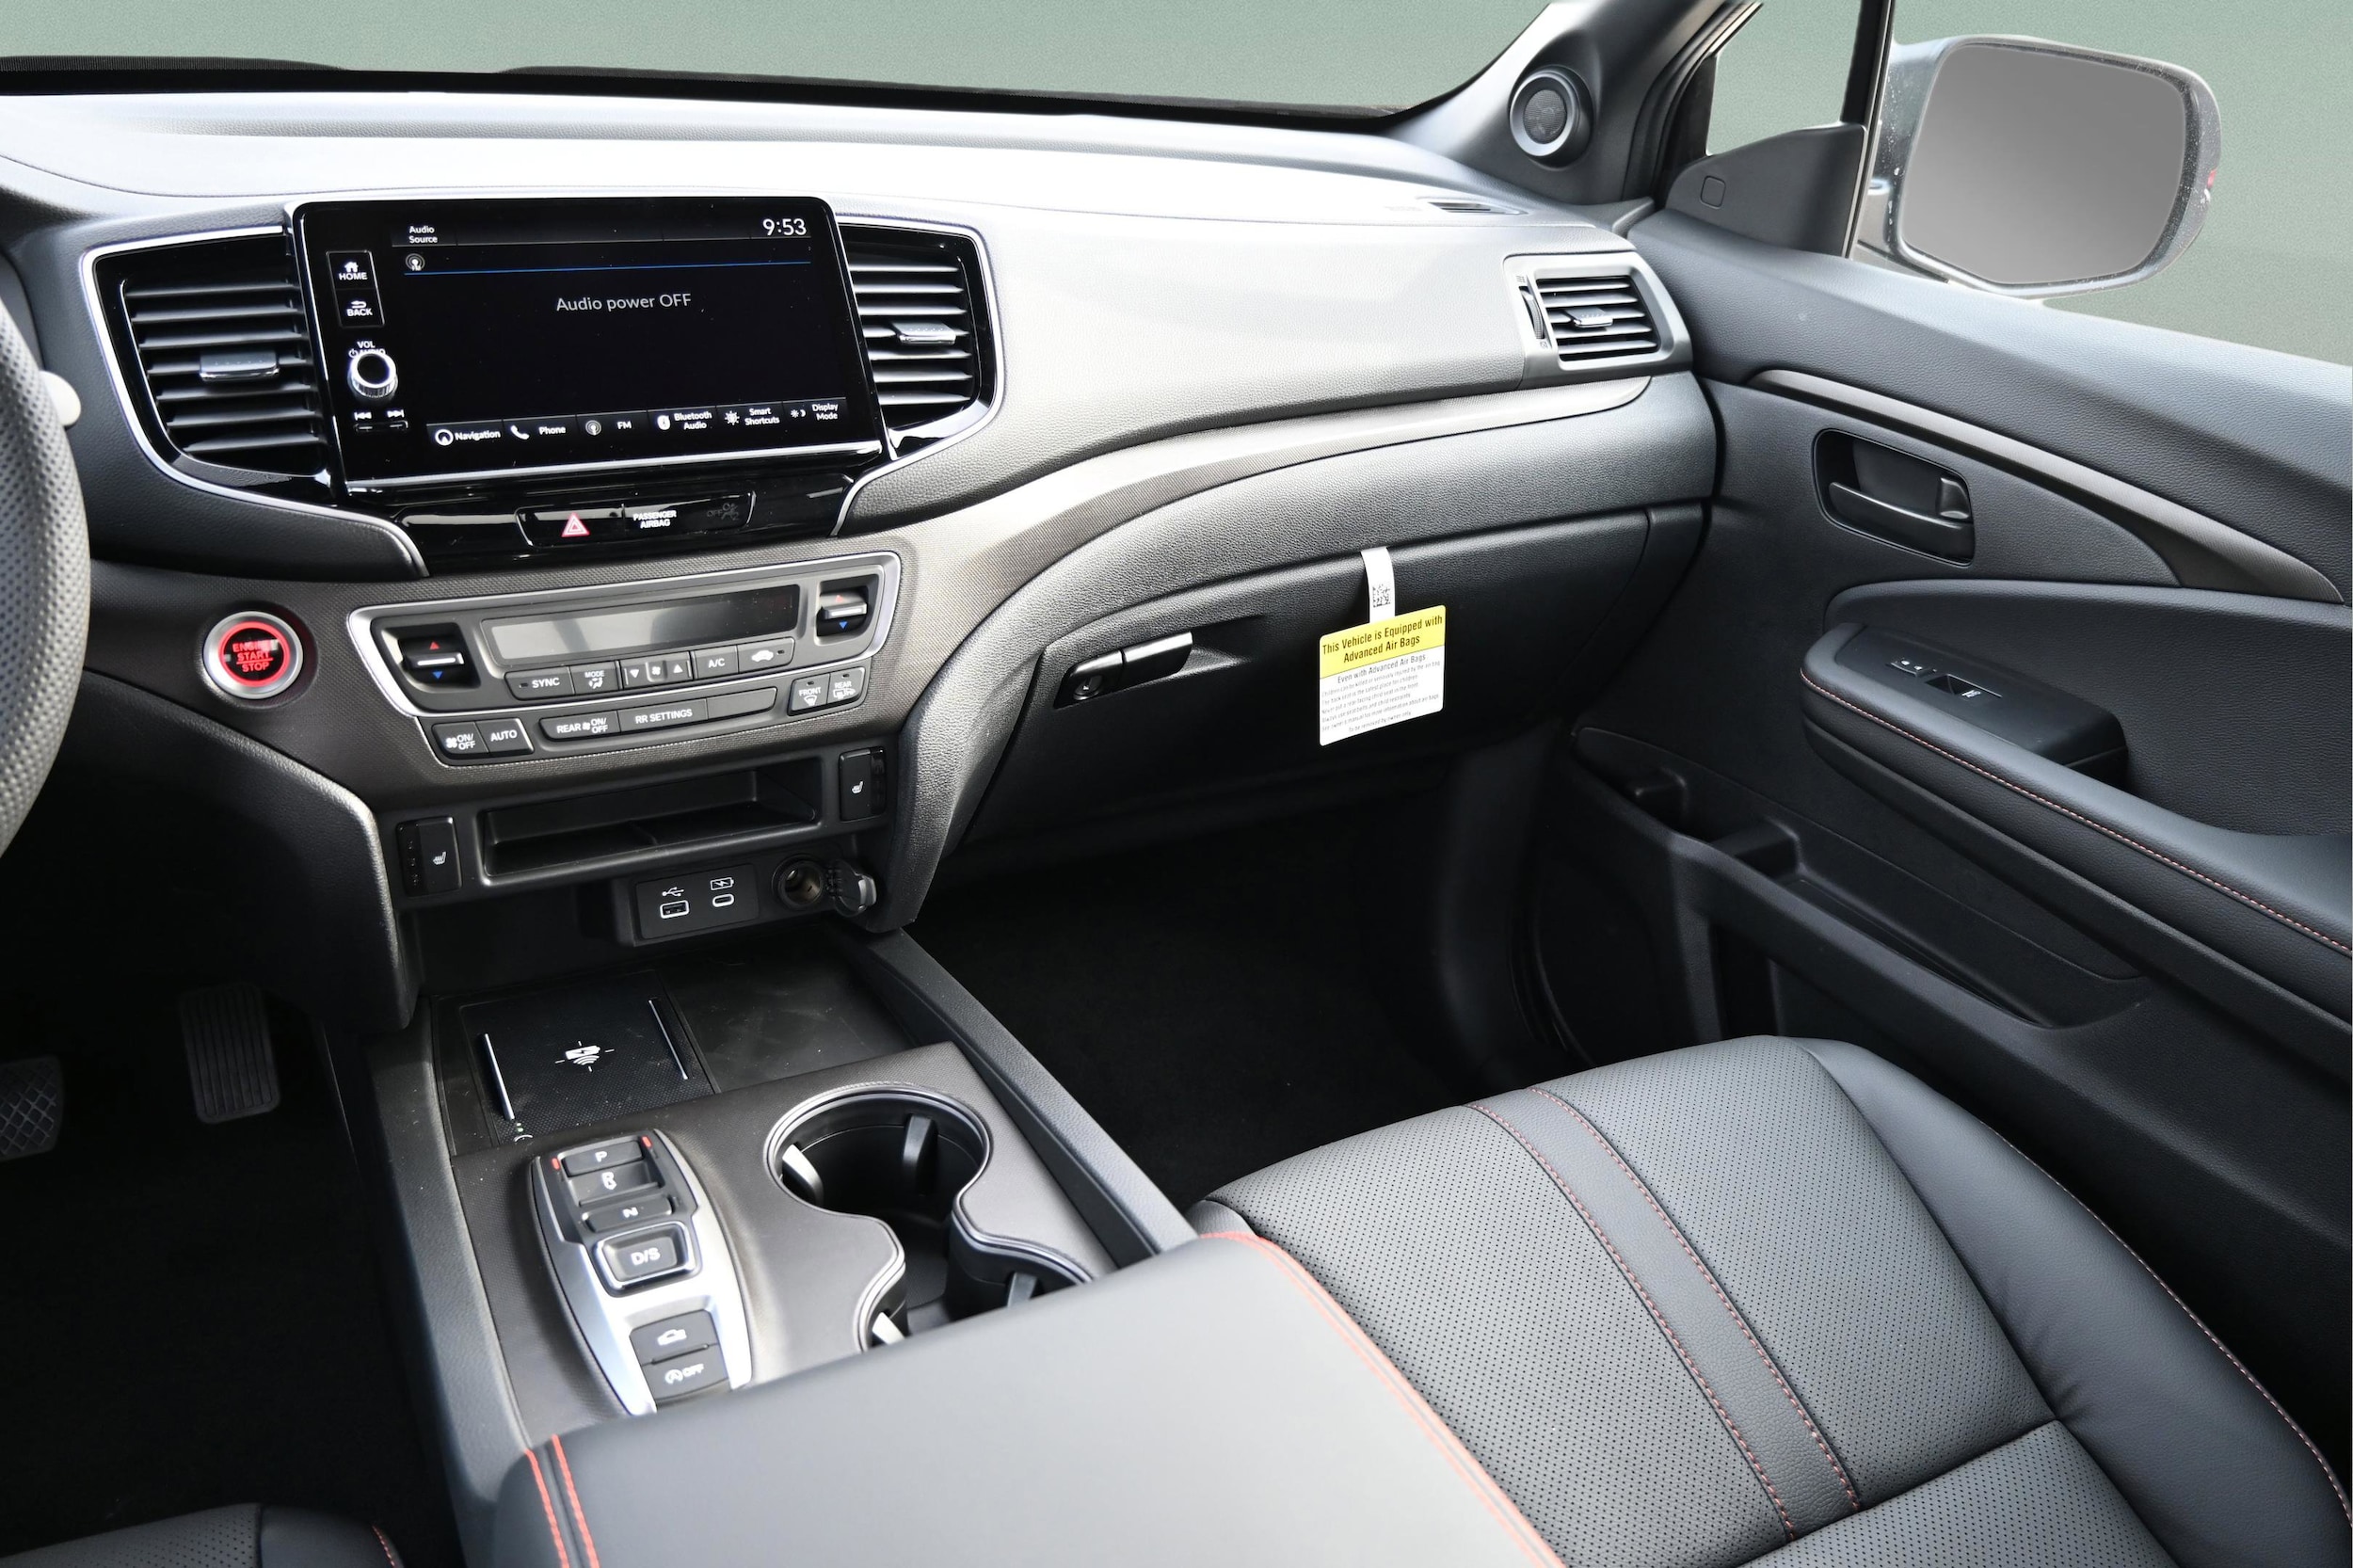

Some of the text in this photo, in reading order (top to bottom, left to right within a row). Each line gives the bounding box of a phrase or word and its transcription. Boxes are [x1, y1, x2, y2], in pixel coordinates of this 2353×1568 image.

[408, 225, 435, 234] Audio
[762, 218, 807, 236] 9:53
[408, 235, 438, 244] Source
[339, 272, 368, 280] HOME
[556, 293, 692, 312] Audio power OFF
[346, 307, 373, 316] BACK
[749, 408, 771, 416] Smart
[812, 403, 839, 413] Display
[674, 410, 712, 422] Bluetooth
[744, 415, 780, 425] Shortcuts
[816, 411, 838, 421] Mode
[538, 425, 567, 436] Phone
[617, 421, 632, 430] FM
[683, 421, 707, 430] Audio
[455, 429, 501, 442] Navigation
[632, 509, 677, 521] PASSENGER
[640, 518, 671, 529] AIRBAG
[1322, 615, 1442, 655] This Vehicle is Equipped with
[1344, 635, 1419, 663] Advanced Air Bags
[237, 650, 270, 662] START
[241, 661, 270, 673] STOP
[708, 658, 726, 668] A/C
[1337, 673, 1352, 683] Even
[1353, 669, 1367, 679] with
[1369, 661, 1398, 675] Advanced
[1410, 653, 1425, 664] Bags
[532, 677, 560, 689] SYNC
[834, 680, 852, 689] REAR
[798, 687, 822, 696] FRONT
[635, 709, 693, 724] RR SETTINGS
[556, 717, 607, 734] REAR ON/
[591, 725, 608, 734] OFF
[457, 733, 474, 743] ON/
[490, 729, 518, 742] AUTO
[458, 740, 475, 750] OFF
[595, 1151, 608, 1162] P
[622, 1207, 638, 1218] N
[631, 1247, 661, 1265] D/S
[682, 1364, 704, 1378] OFF
